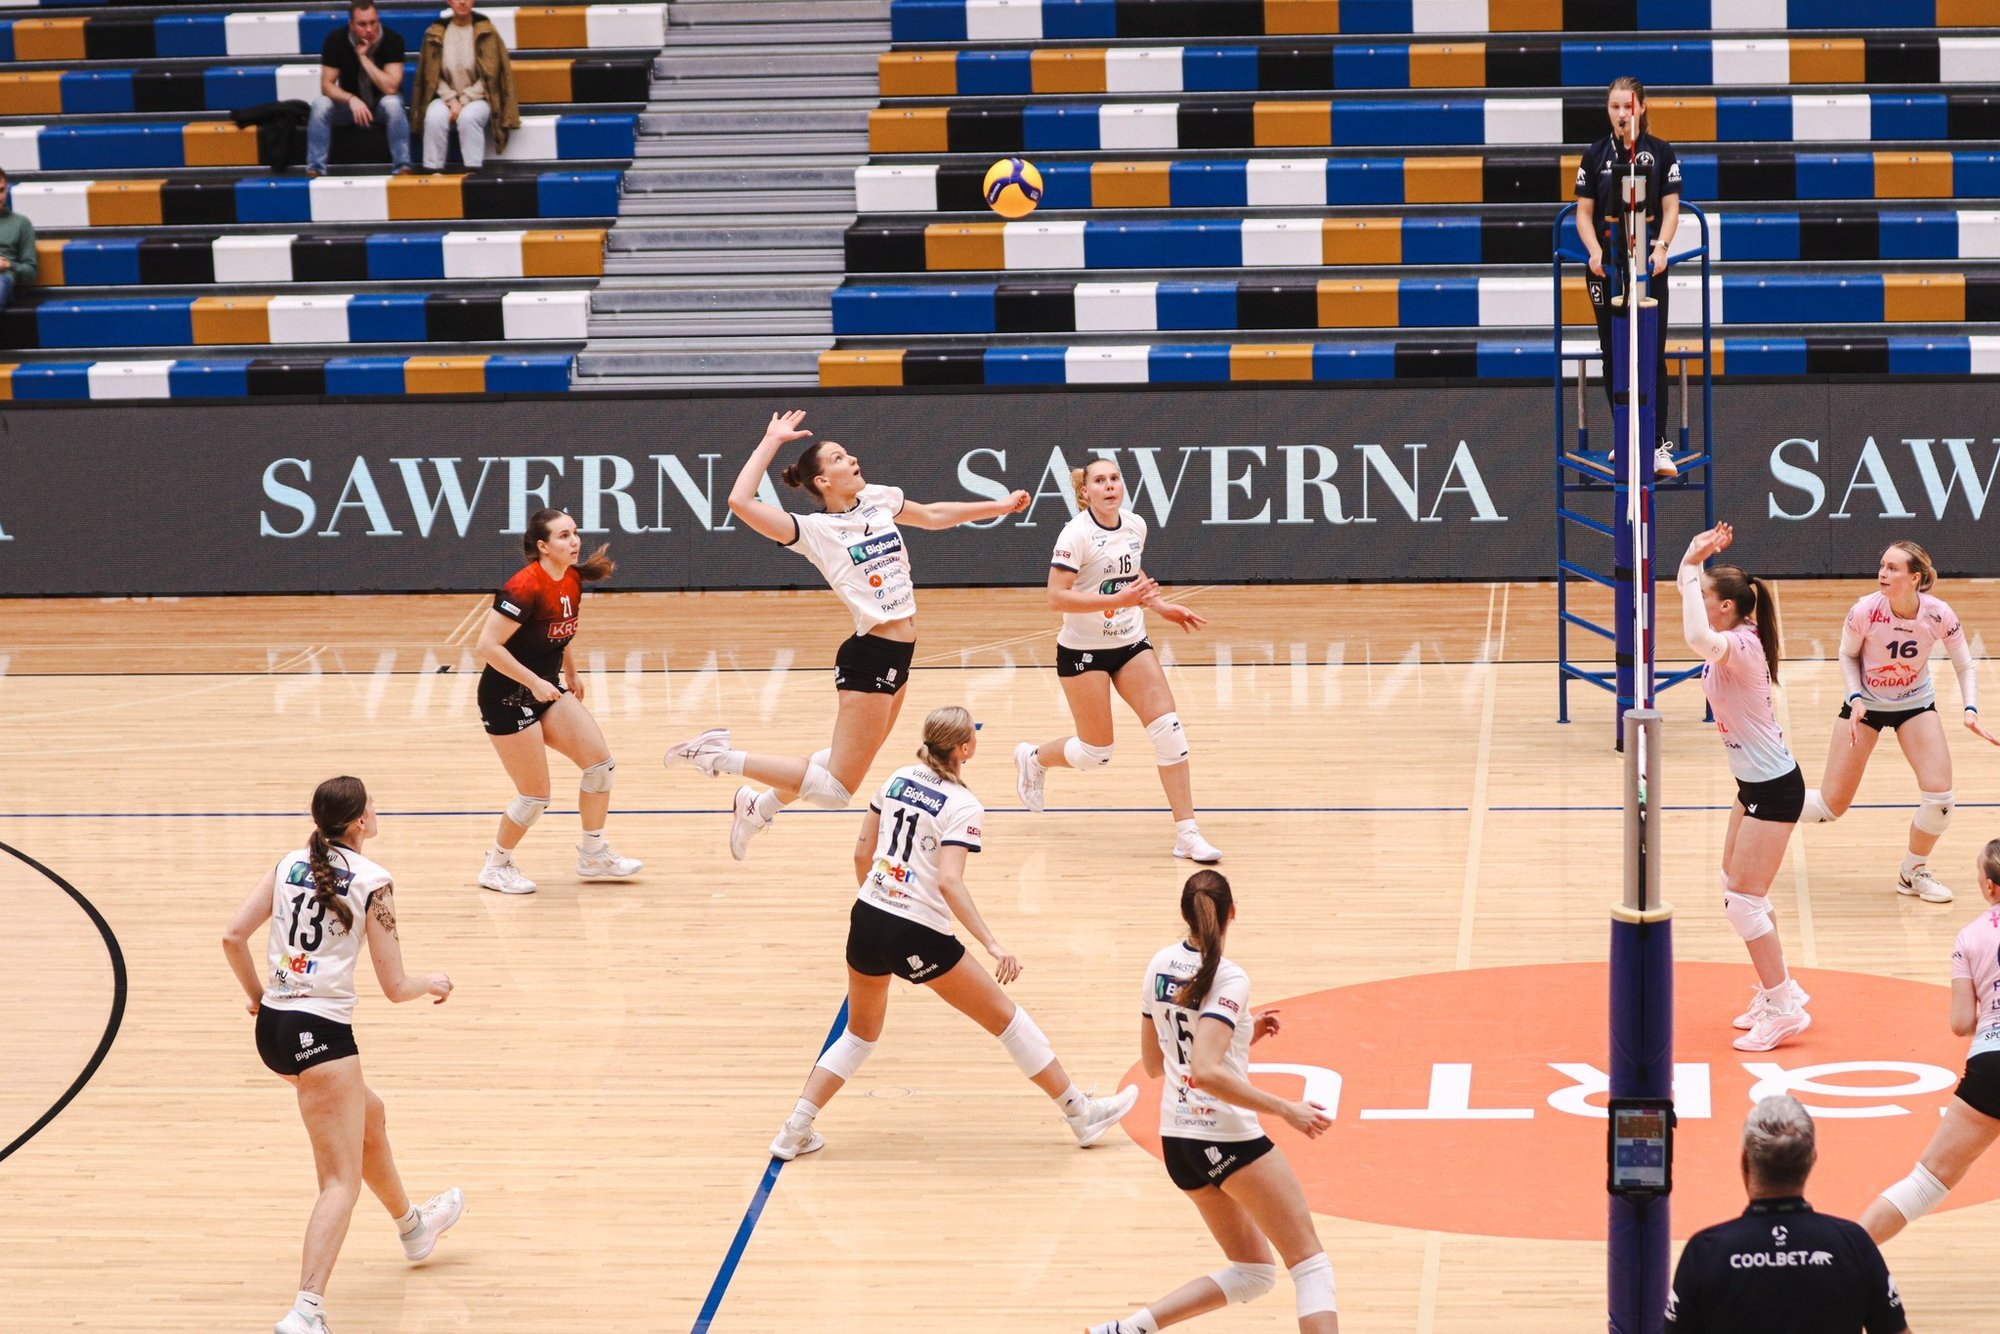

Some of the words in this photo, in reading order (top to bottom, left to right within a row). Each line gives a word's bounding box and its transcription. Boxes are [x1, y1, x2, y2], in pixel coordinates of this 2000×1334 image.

[1119, 554, 1132, 575] 16
[560, 594, 573, 618] 21
[1886, 640, 1918, 659] 16
[1075, 662, 1085, 671] 16
[902, 785, 943, 811] Bigbank
[887, 807, 919, 863] 11
[288, 892, 326, 951] 13
[909, 962, 939, 980] Bigbank
[294, 1042, 329, 1062] Bigbank
[1208, 1153, 1238, 1179] Bigbank
[1730, 1251, 1809, 1269] COOLBET
